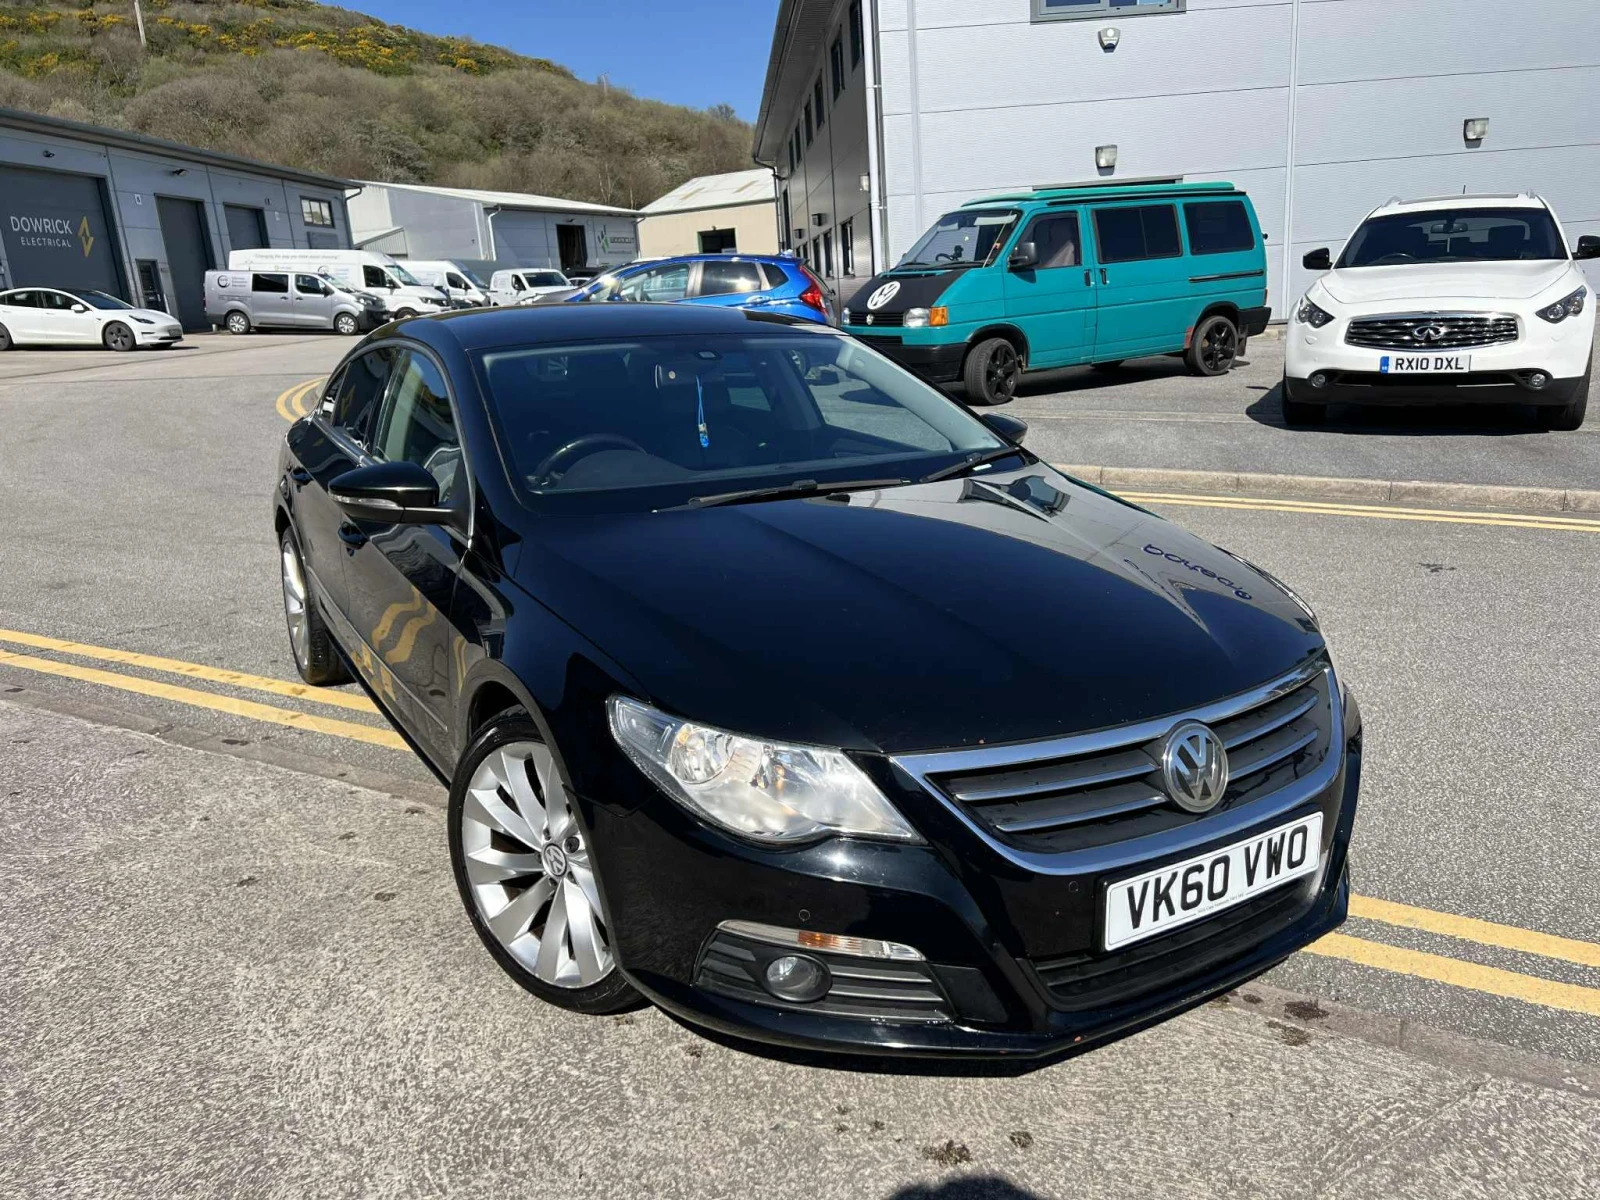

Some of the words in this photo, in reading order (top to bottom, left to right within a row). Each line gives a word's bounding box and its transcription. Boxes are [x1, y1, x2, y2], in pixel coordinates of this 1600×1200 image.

[10, 215, 73, 235] DOWRICK
[20, 236, 72, 248] ELECTRICAL
[1395, 357, 1430, 371] RX10
[1434, 356, 1464, 370] DXL
[1126, 854, 1231, 930] VK60
[1244, 824, 1308, 887] VWO
